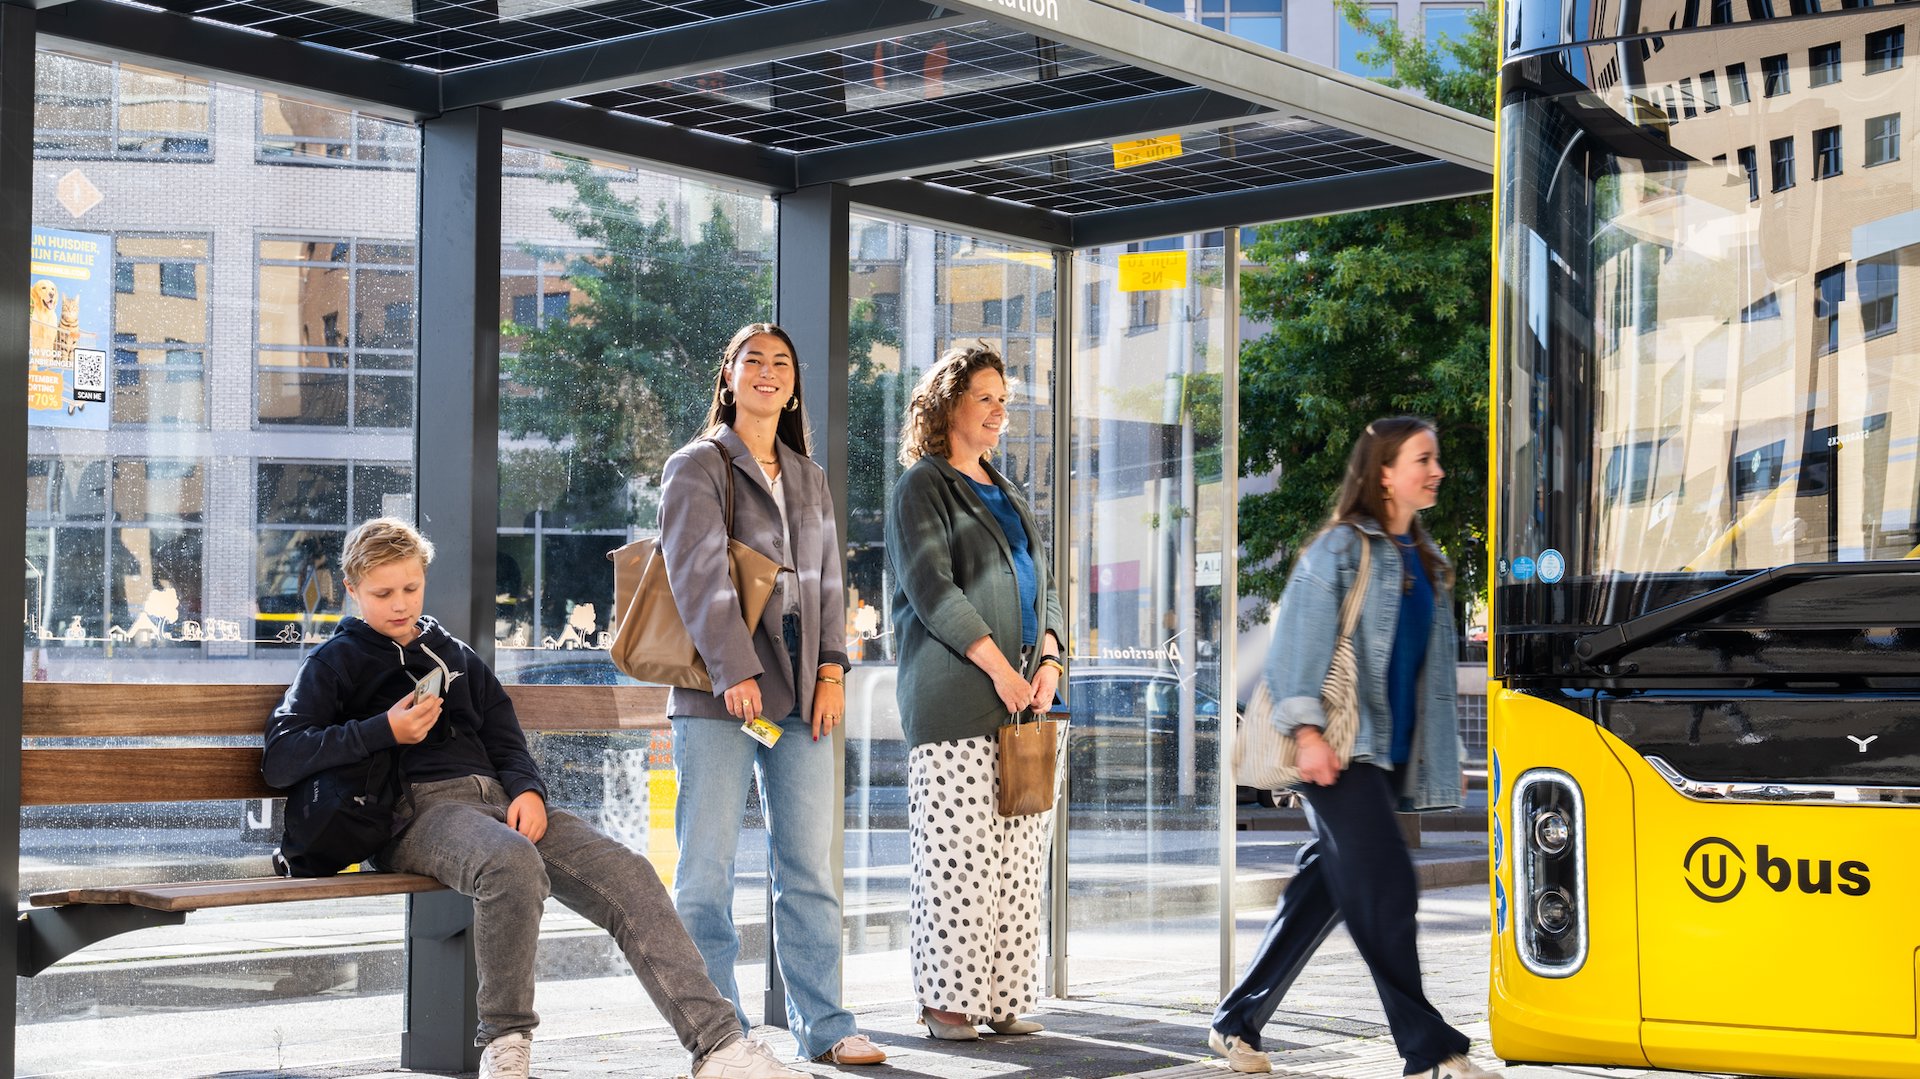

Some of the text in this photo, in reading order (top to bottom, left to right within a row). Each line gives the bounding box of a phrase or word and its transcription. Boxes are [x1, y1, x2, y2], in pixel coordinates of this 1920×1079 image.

[48, 236, 100, 255] HUISDIER,
[53, 249, 95, 266] FAMILIE
[29, 348, 40, 356] AN
[28, 374, 59, 384] PTEMBER
[28, 383, 55, 393] ORTING
[34, 393, 59, 407] 70%
[77, 391, 102, 401] SCAN ME
[1756, 844, 1871, 896] bus
